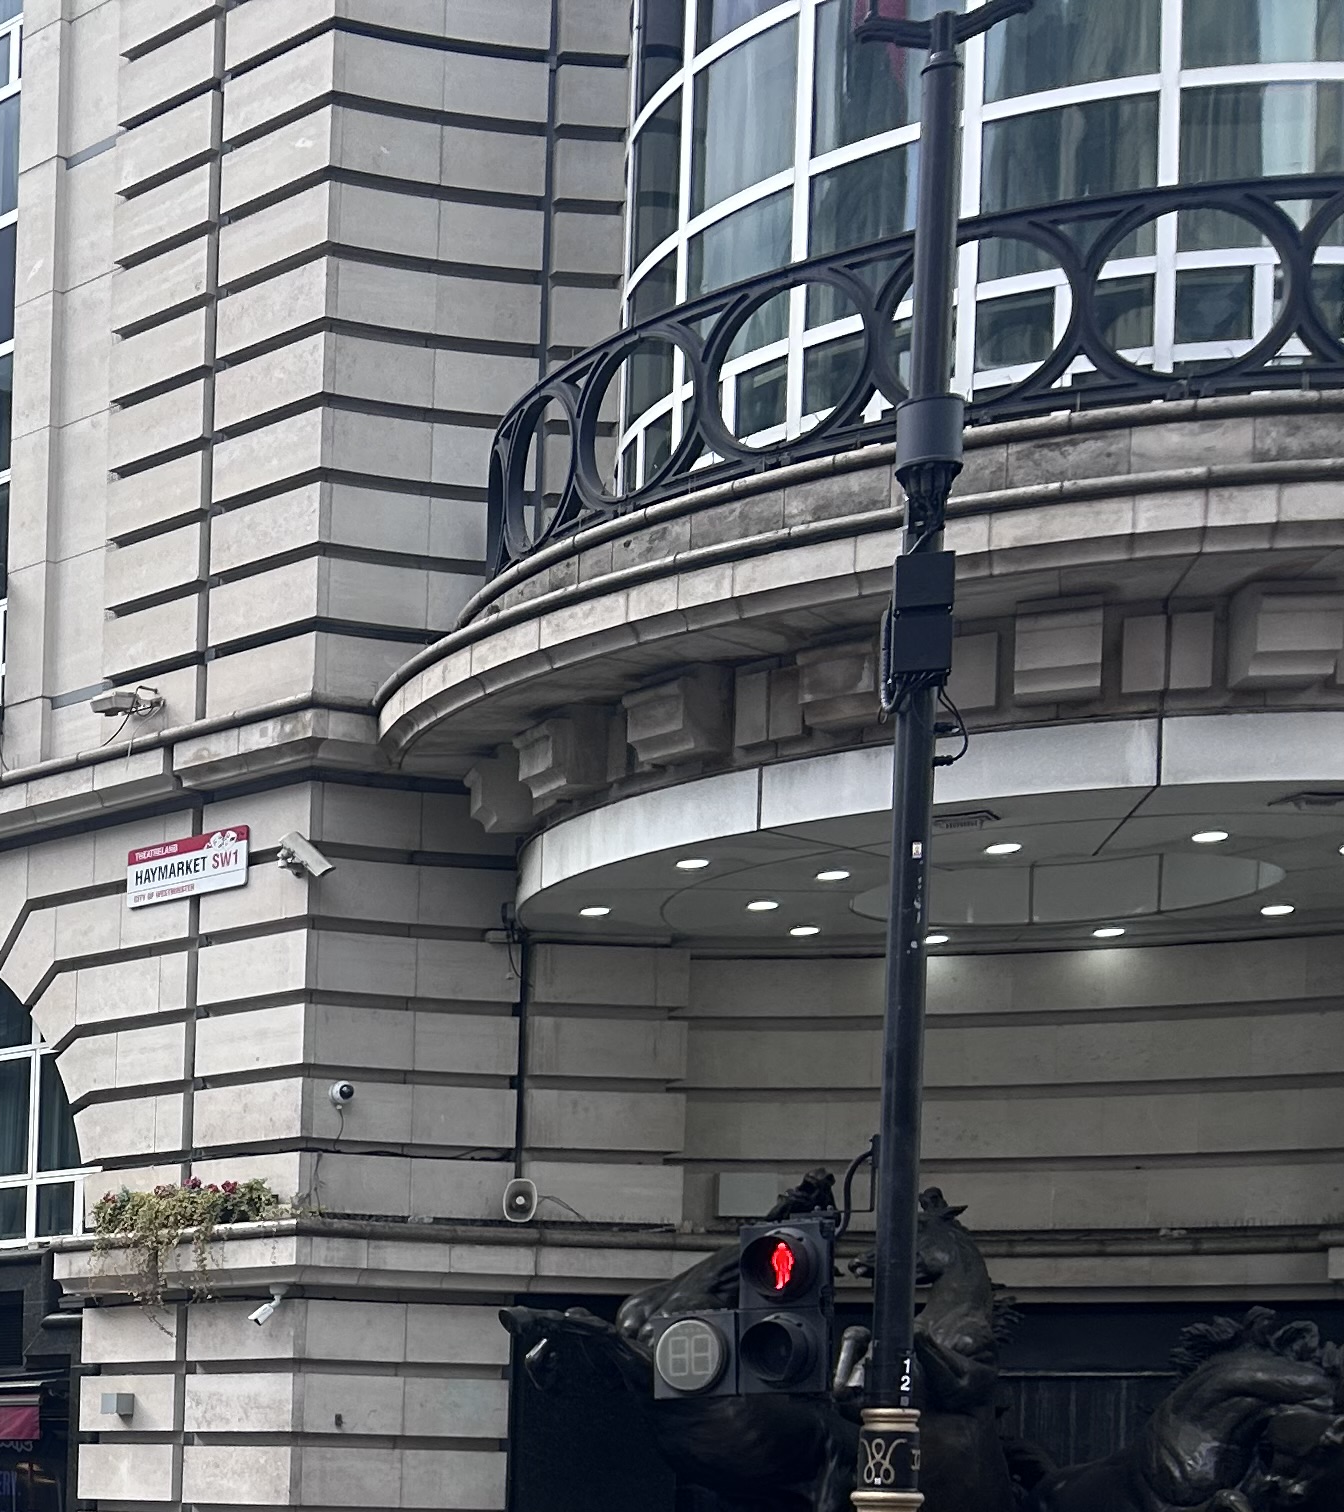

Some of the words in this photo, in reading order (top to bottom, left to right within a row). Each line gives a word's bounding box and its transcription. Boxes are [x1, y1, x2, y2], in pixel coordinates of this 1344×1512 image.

[135, 856, 208, 886] HAYMARKET
[212, 849, 239, 869] SW1
[134, 892, 146, 903] CITY
[147, 891, 155, 900] OF
[156, 883, 194, 899] WESTMINSTER
